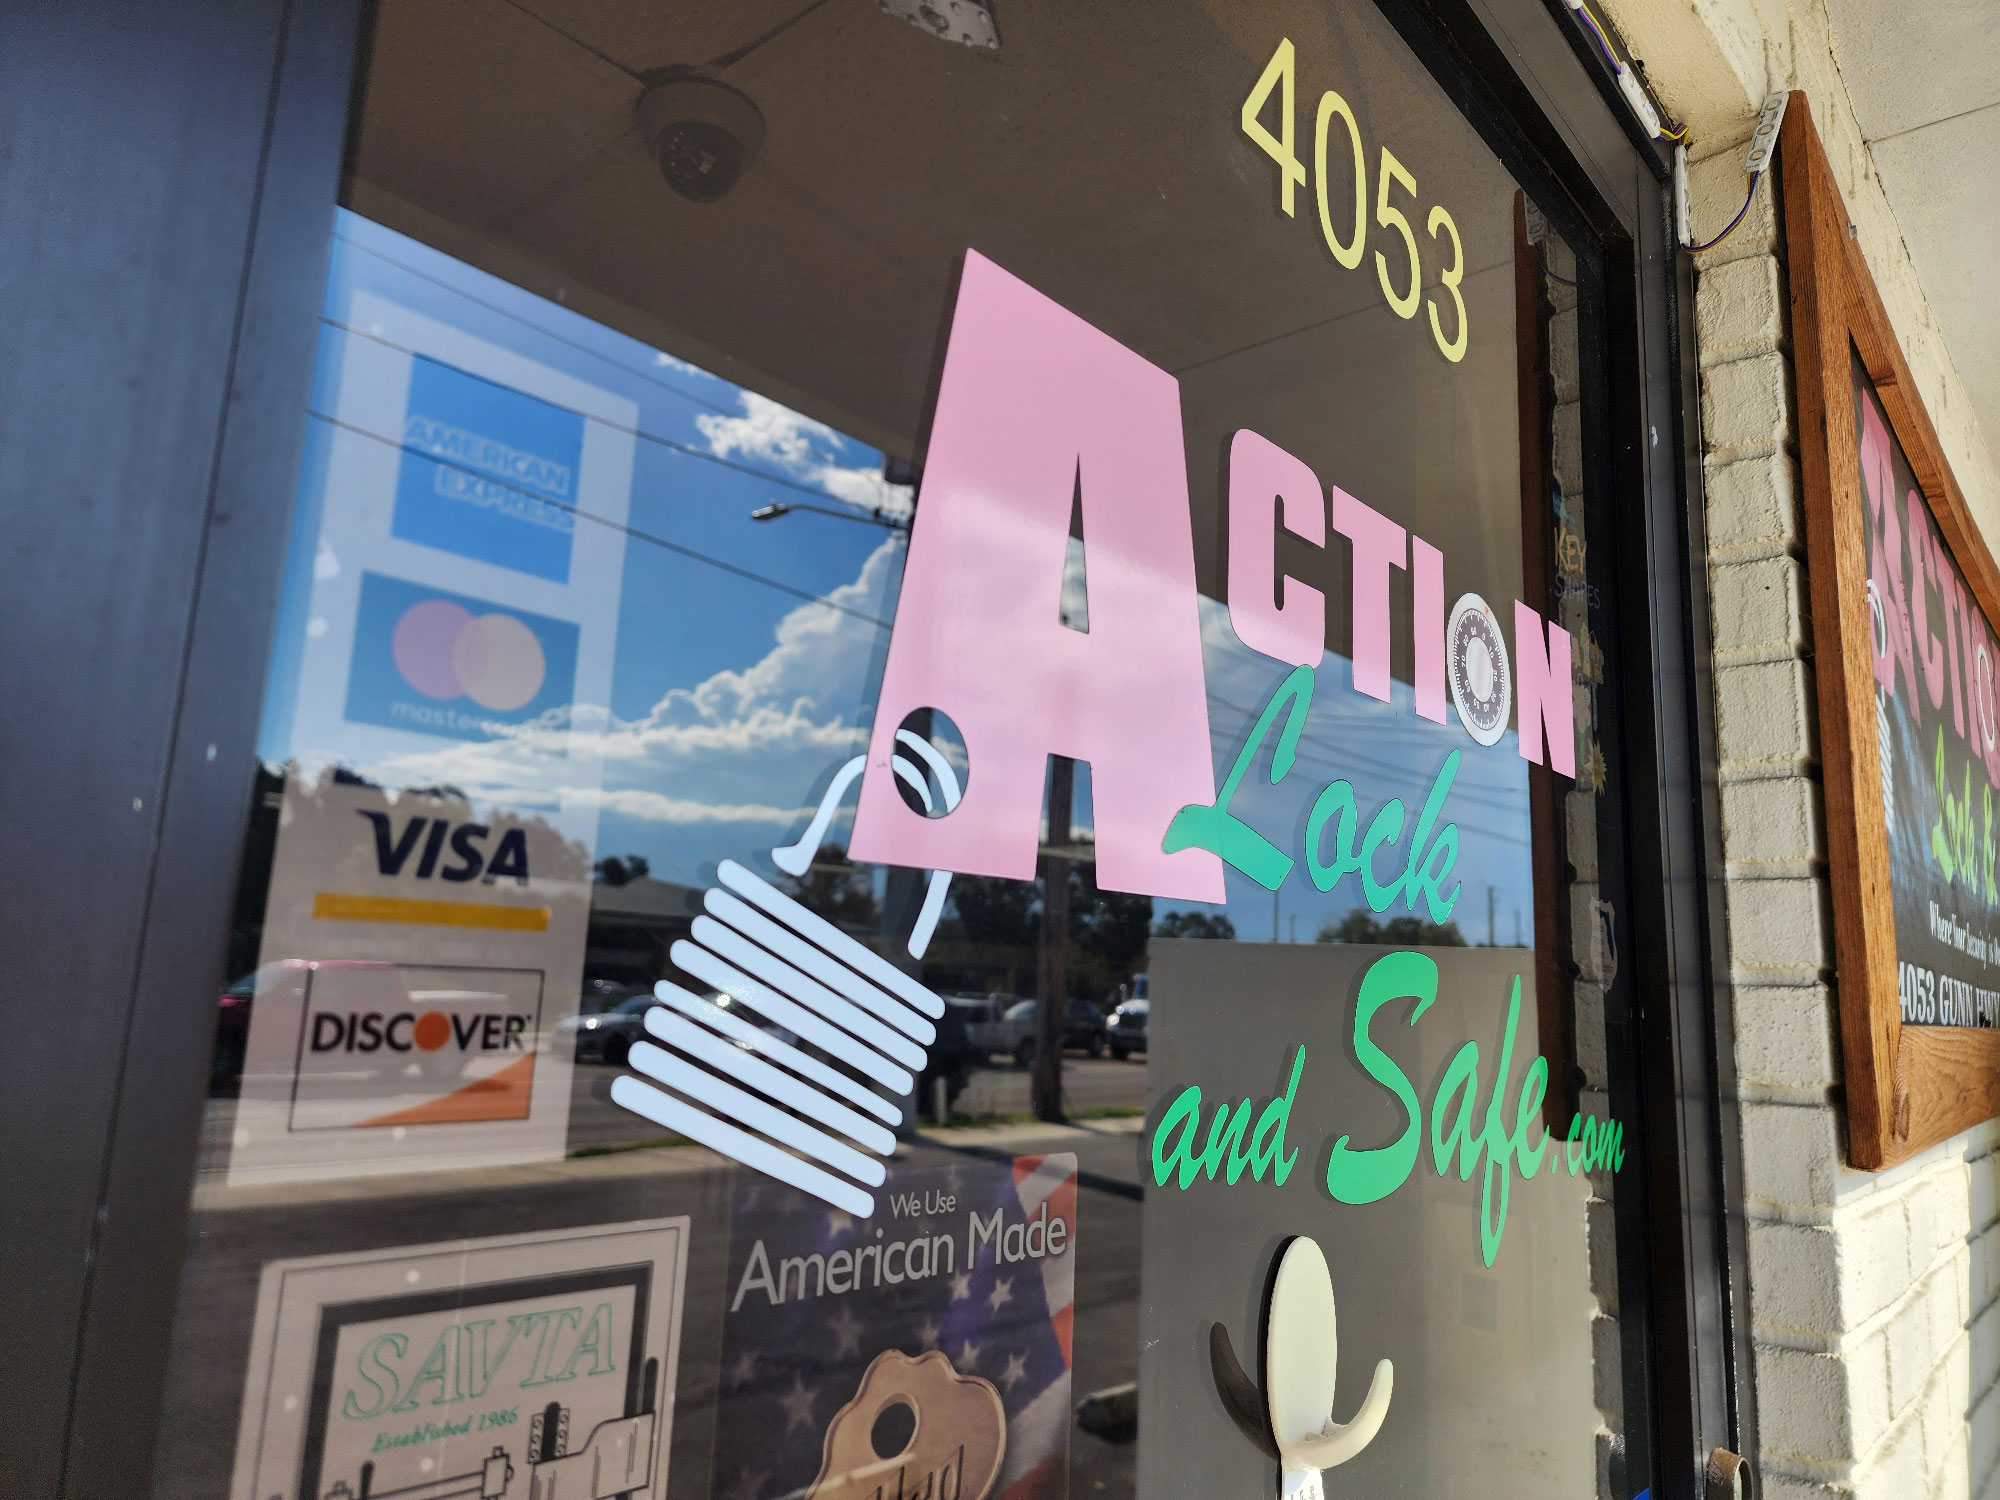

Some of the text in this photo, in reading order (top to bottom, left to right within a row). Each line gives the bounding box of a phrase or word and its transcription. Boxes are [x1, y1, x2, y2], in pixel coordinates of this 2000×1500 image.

[1242, 37, 1468, 362] 4053
[404, 414, 571, 496] AMERICAN
[434, 462, 576, 534] EXPRESS
[847, 247, 1576, 905] ACTION
[1554, 526, 1588, 575] KEY
[1860, 386, 2000, 790] ACTIO
[1554, 573, 1601, 610] SHAPES
[1162, 664, 1462, 926] Lock
[1931, 723, 1978, 894] Lock
[357, 808, 530, 887] VISA
[1930, 900, 1952, 945] Where
[311, 1009, 527, 1052] DISCOVER
[1899, 961, 2000, 1028] 4053 GUNN HWY
[1152, 1044, 1306, 1190] and
[890, 1189, 956, 1219] We Use
[730, 1201, 1067, 1313] American Made
[341, 1302, 616, 1422] SAVTA
[371, 1406, 520, 1453] Established 1986
